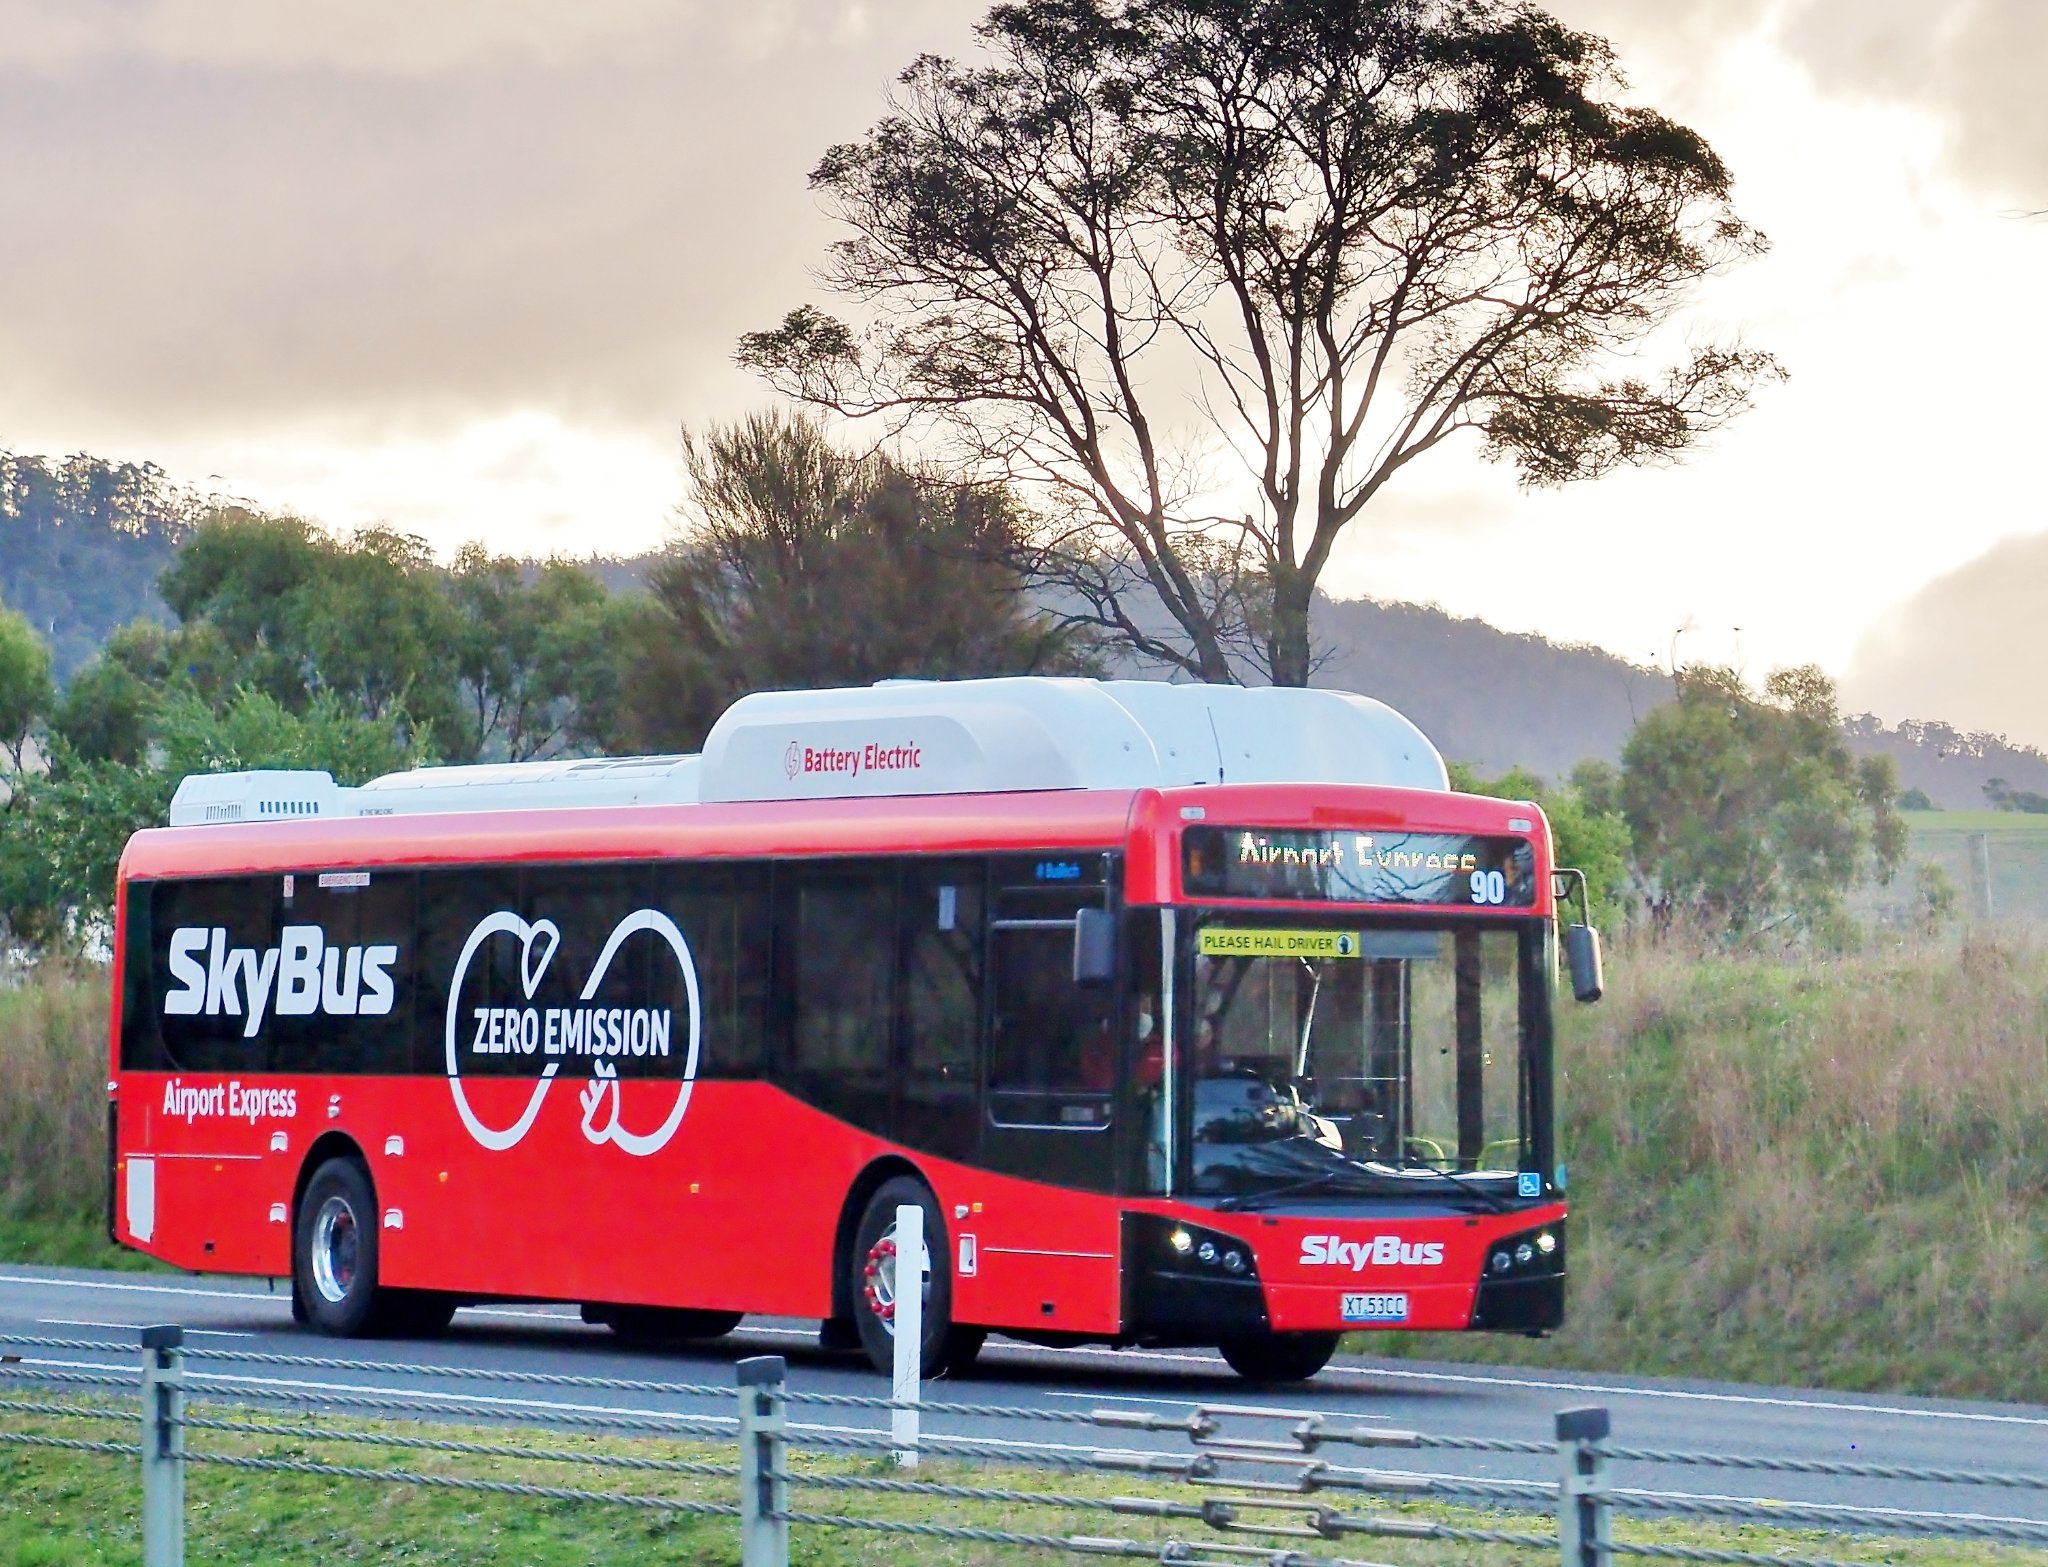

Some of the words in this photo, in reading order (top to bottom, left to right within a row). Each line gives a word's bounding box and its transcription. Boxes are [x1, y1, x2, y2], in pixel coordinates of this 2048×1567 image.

[804, 747, 860, 778] Battery
[864, 740, 920, 770] Electric
[1470, 870, 1505, 904] 90
[1204, 936, 1250, 949] PLEASE
[1254, 937, 1283, 949] HAIL
[1288, 938, 1333, 950] DRIVER
[164, 925, 398, 1038] SkyBus
[472, 1007, 539, 1055] ZERO
[544, 1008, 671, 1057] EMISSION
[163, 1077, 225, 1125] Airport
[229, 1081, 297, 1126] Express
[1299, 1235, 1445, 1272] SkyBus
